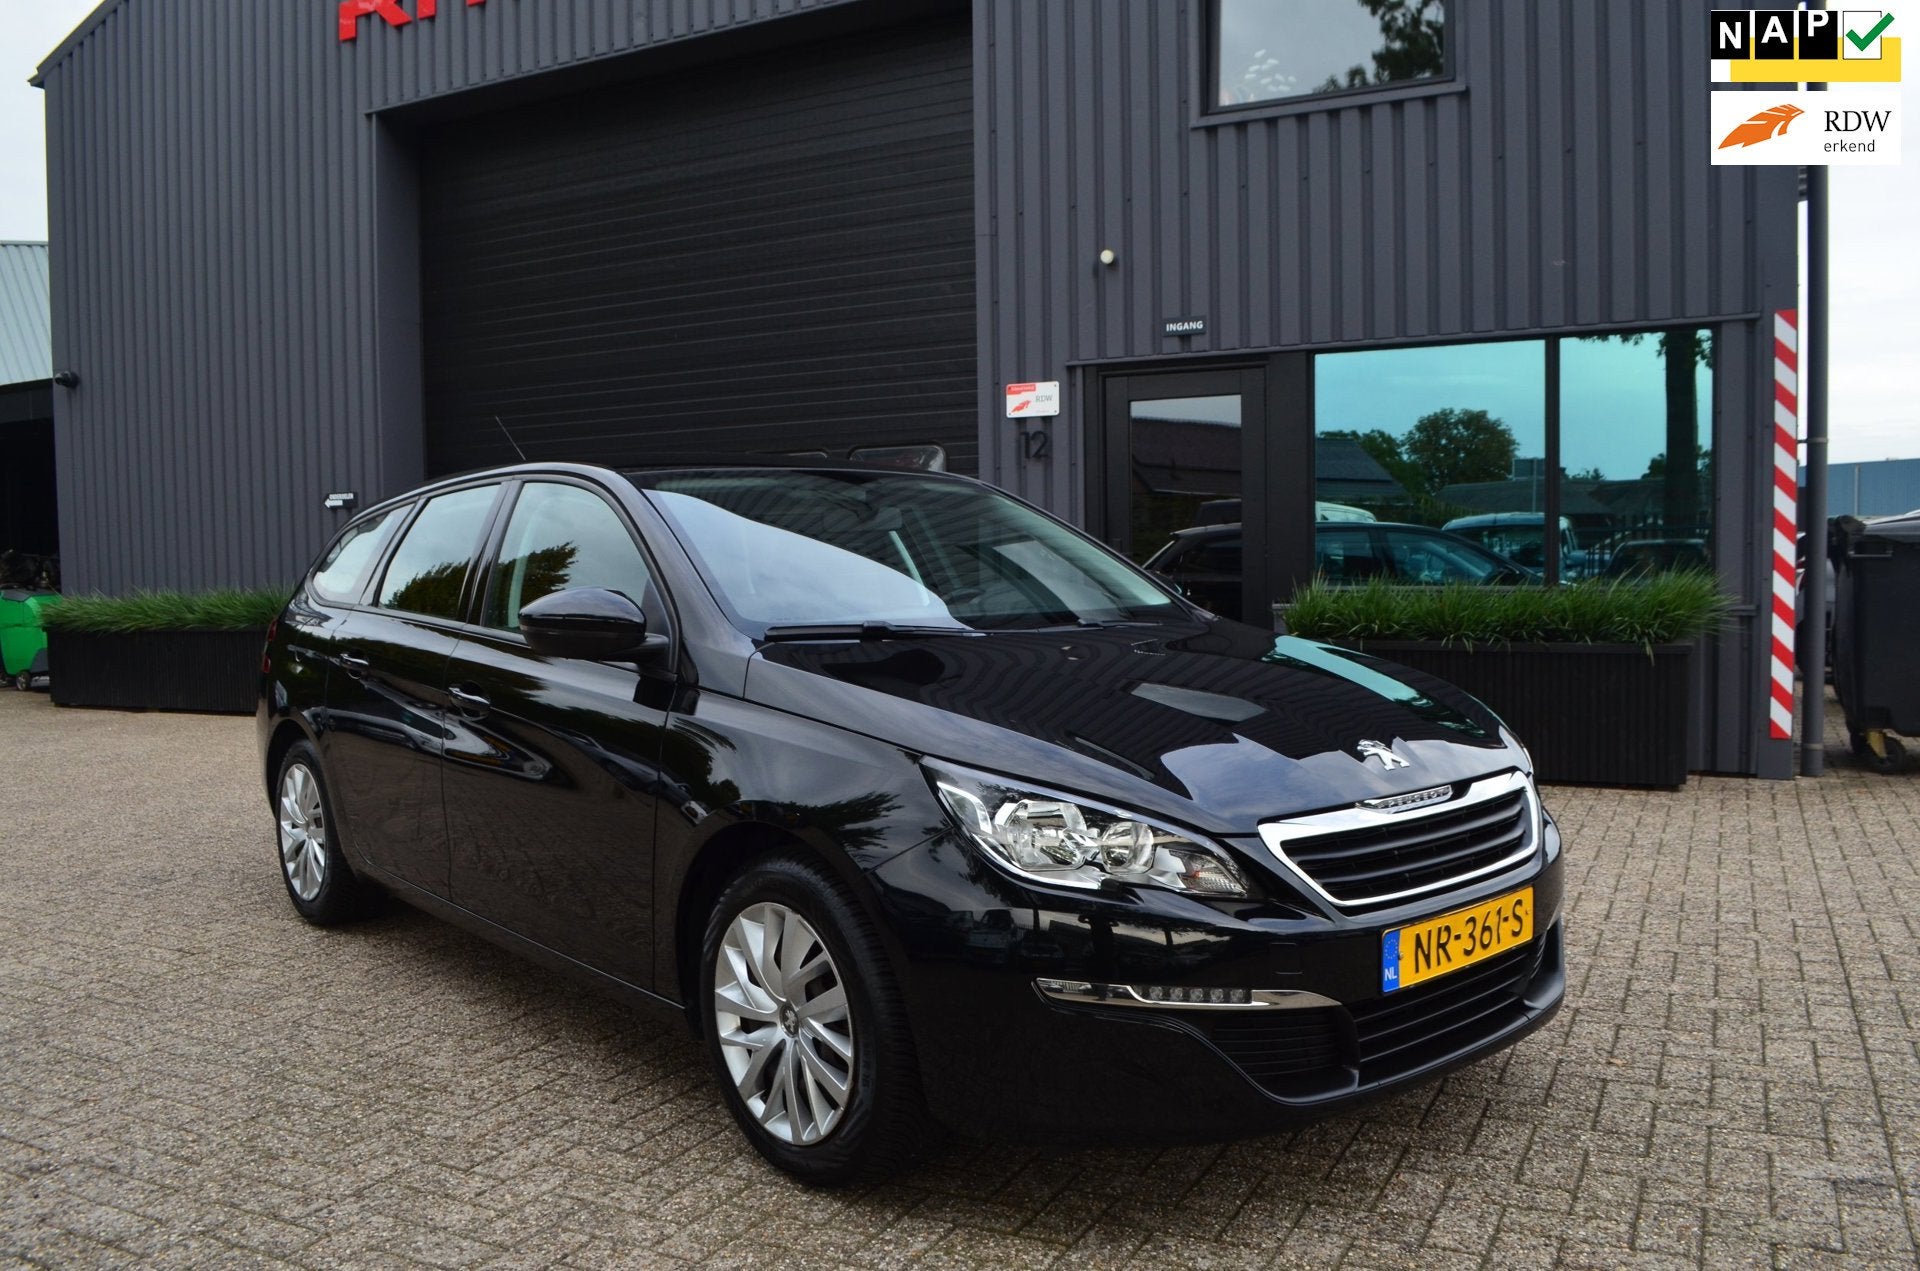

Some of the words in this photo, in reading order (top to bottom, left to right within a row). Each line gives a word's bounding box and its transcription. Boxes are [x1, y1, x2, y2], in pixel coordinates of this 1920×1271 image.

[1166, 321, 1203, 332] INGANG
[1035, 394, 1053, 402] RDW
[1020, 431, 1048, 459] 12
[1414, 898, 1523, 974] NR-361-S
[1384, 966, 1397, 981] NL
